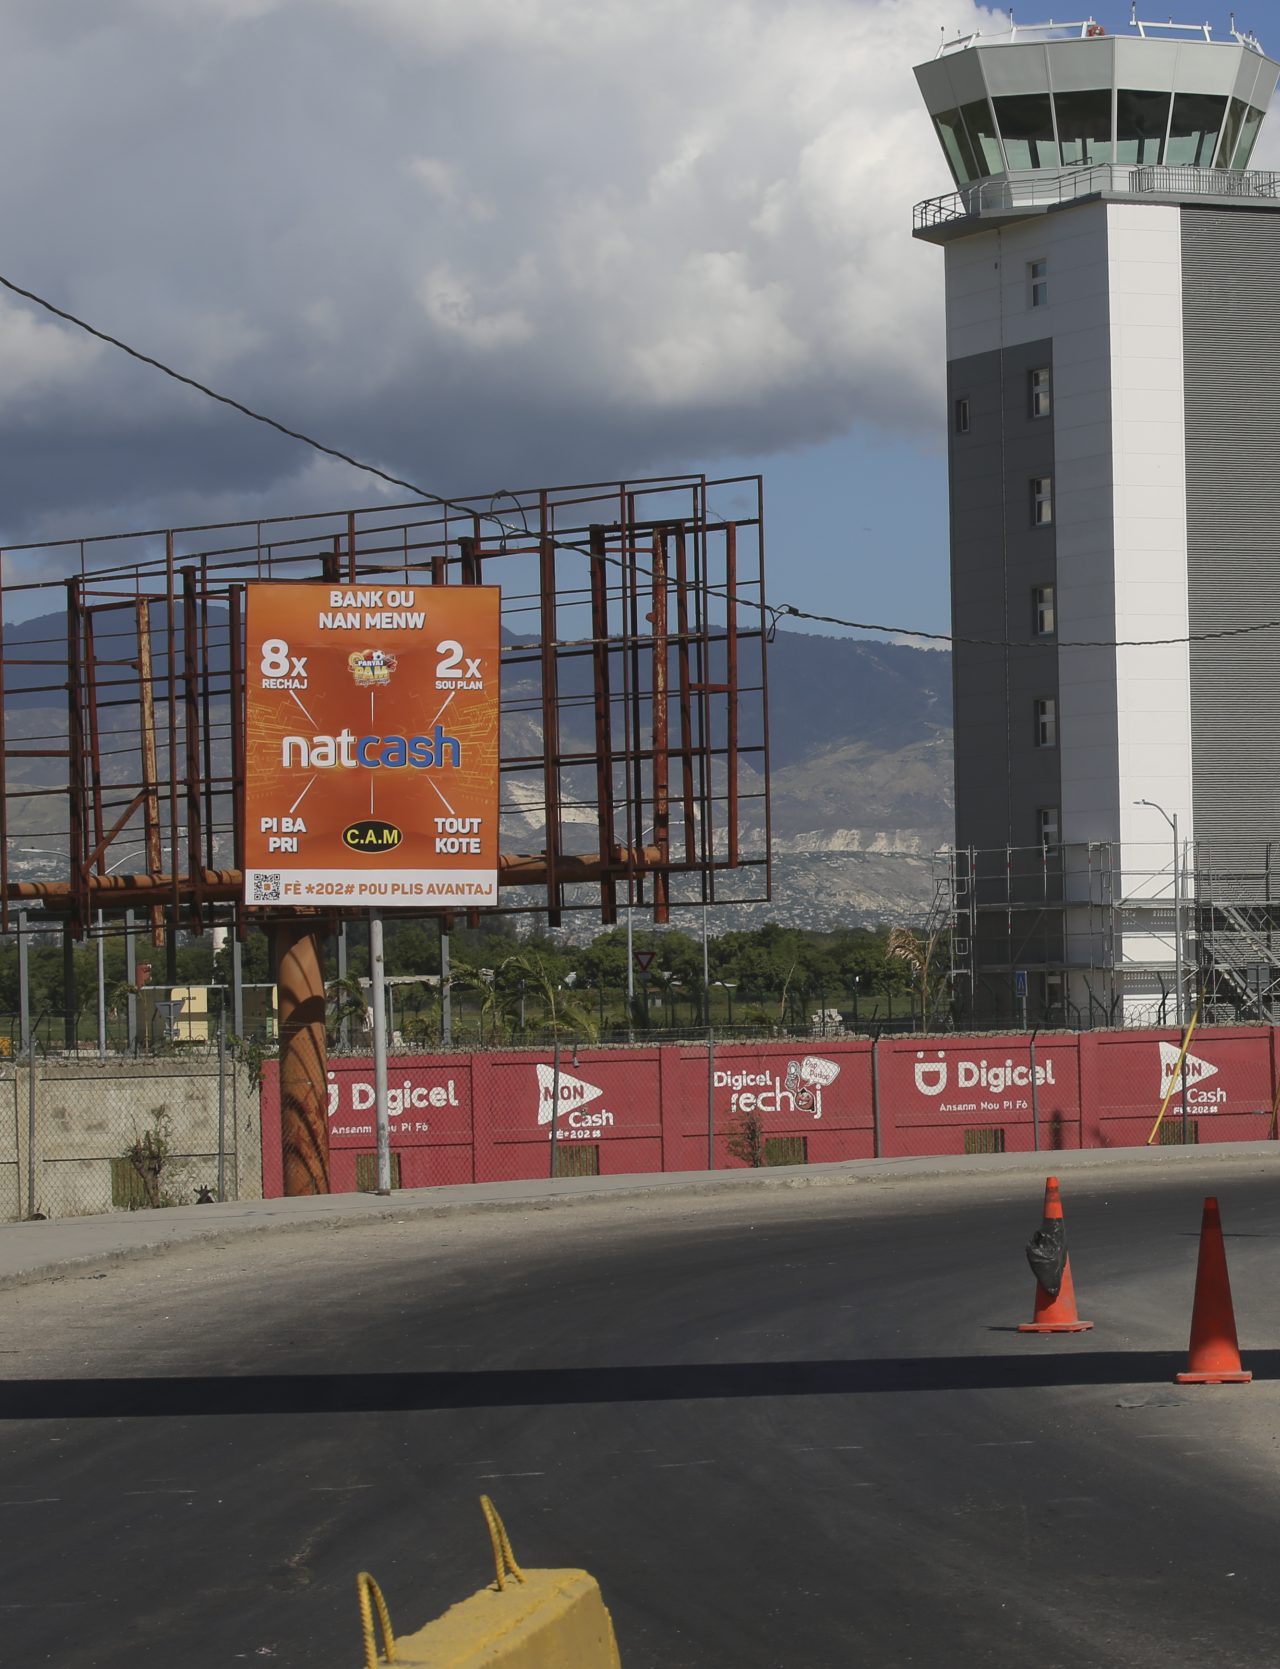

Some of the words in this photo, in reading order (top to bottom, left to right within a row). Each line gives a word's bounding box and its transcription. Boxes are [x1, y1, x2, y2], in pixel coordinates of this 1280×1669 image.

[330, 590, 383, 608] BANK
[386, 590, 415, 608] OU
[319, 612, 361, 630] NAN
[365, 612, 425, 630] MENW
[262, 678, 308, 690] RECHAJ
[435, 680, 456, 690] SOU
[458, 680, 483, 690] PLAN
[281, 724, 462, 769] natcash
[260, 817, 278, 833] PI
[281, 817, 307, 833] BA
[434, 817, 482, 834] TOUT
[268, 837, 299, 853] PRI
[346, 828, 400, 845] C.A.M
[435, 837, 481, 854] KOTE
[358, 883, 391, 896] POU
[392, 883, 424, 896] PLIS
[426, 883, 493, 896] AVANTAJ
[713, 1069, 773, 1090] Digicel
[957, 1059, 1056, 1093] Digicel
[351, 1079, 459, 1116] Dgicel
[1186, 1087, 1227, 1103] Cash
[980, 1101, 1000, 1110] Nou
[568, 1109, 614, 1128] Cash
